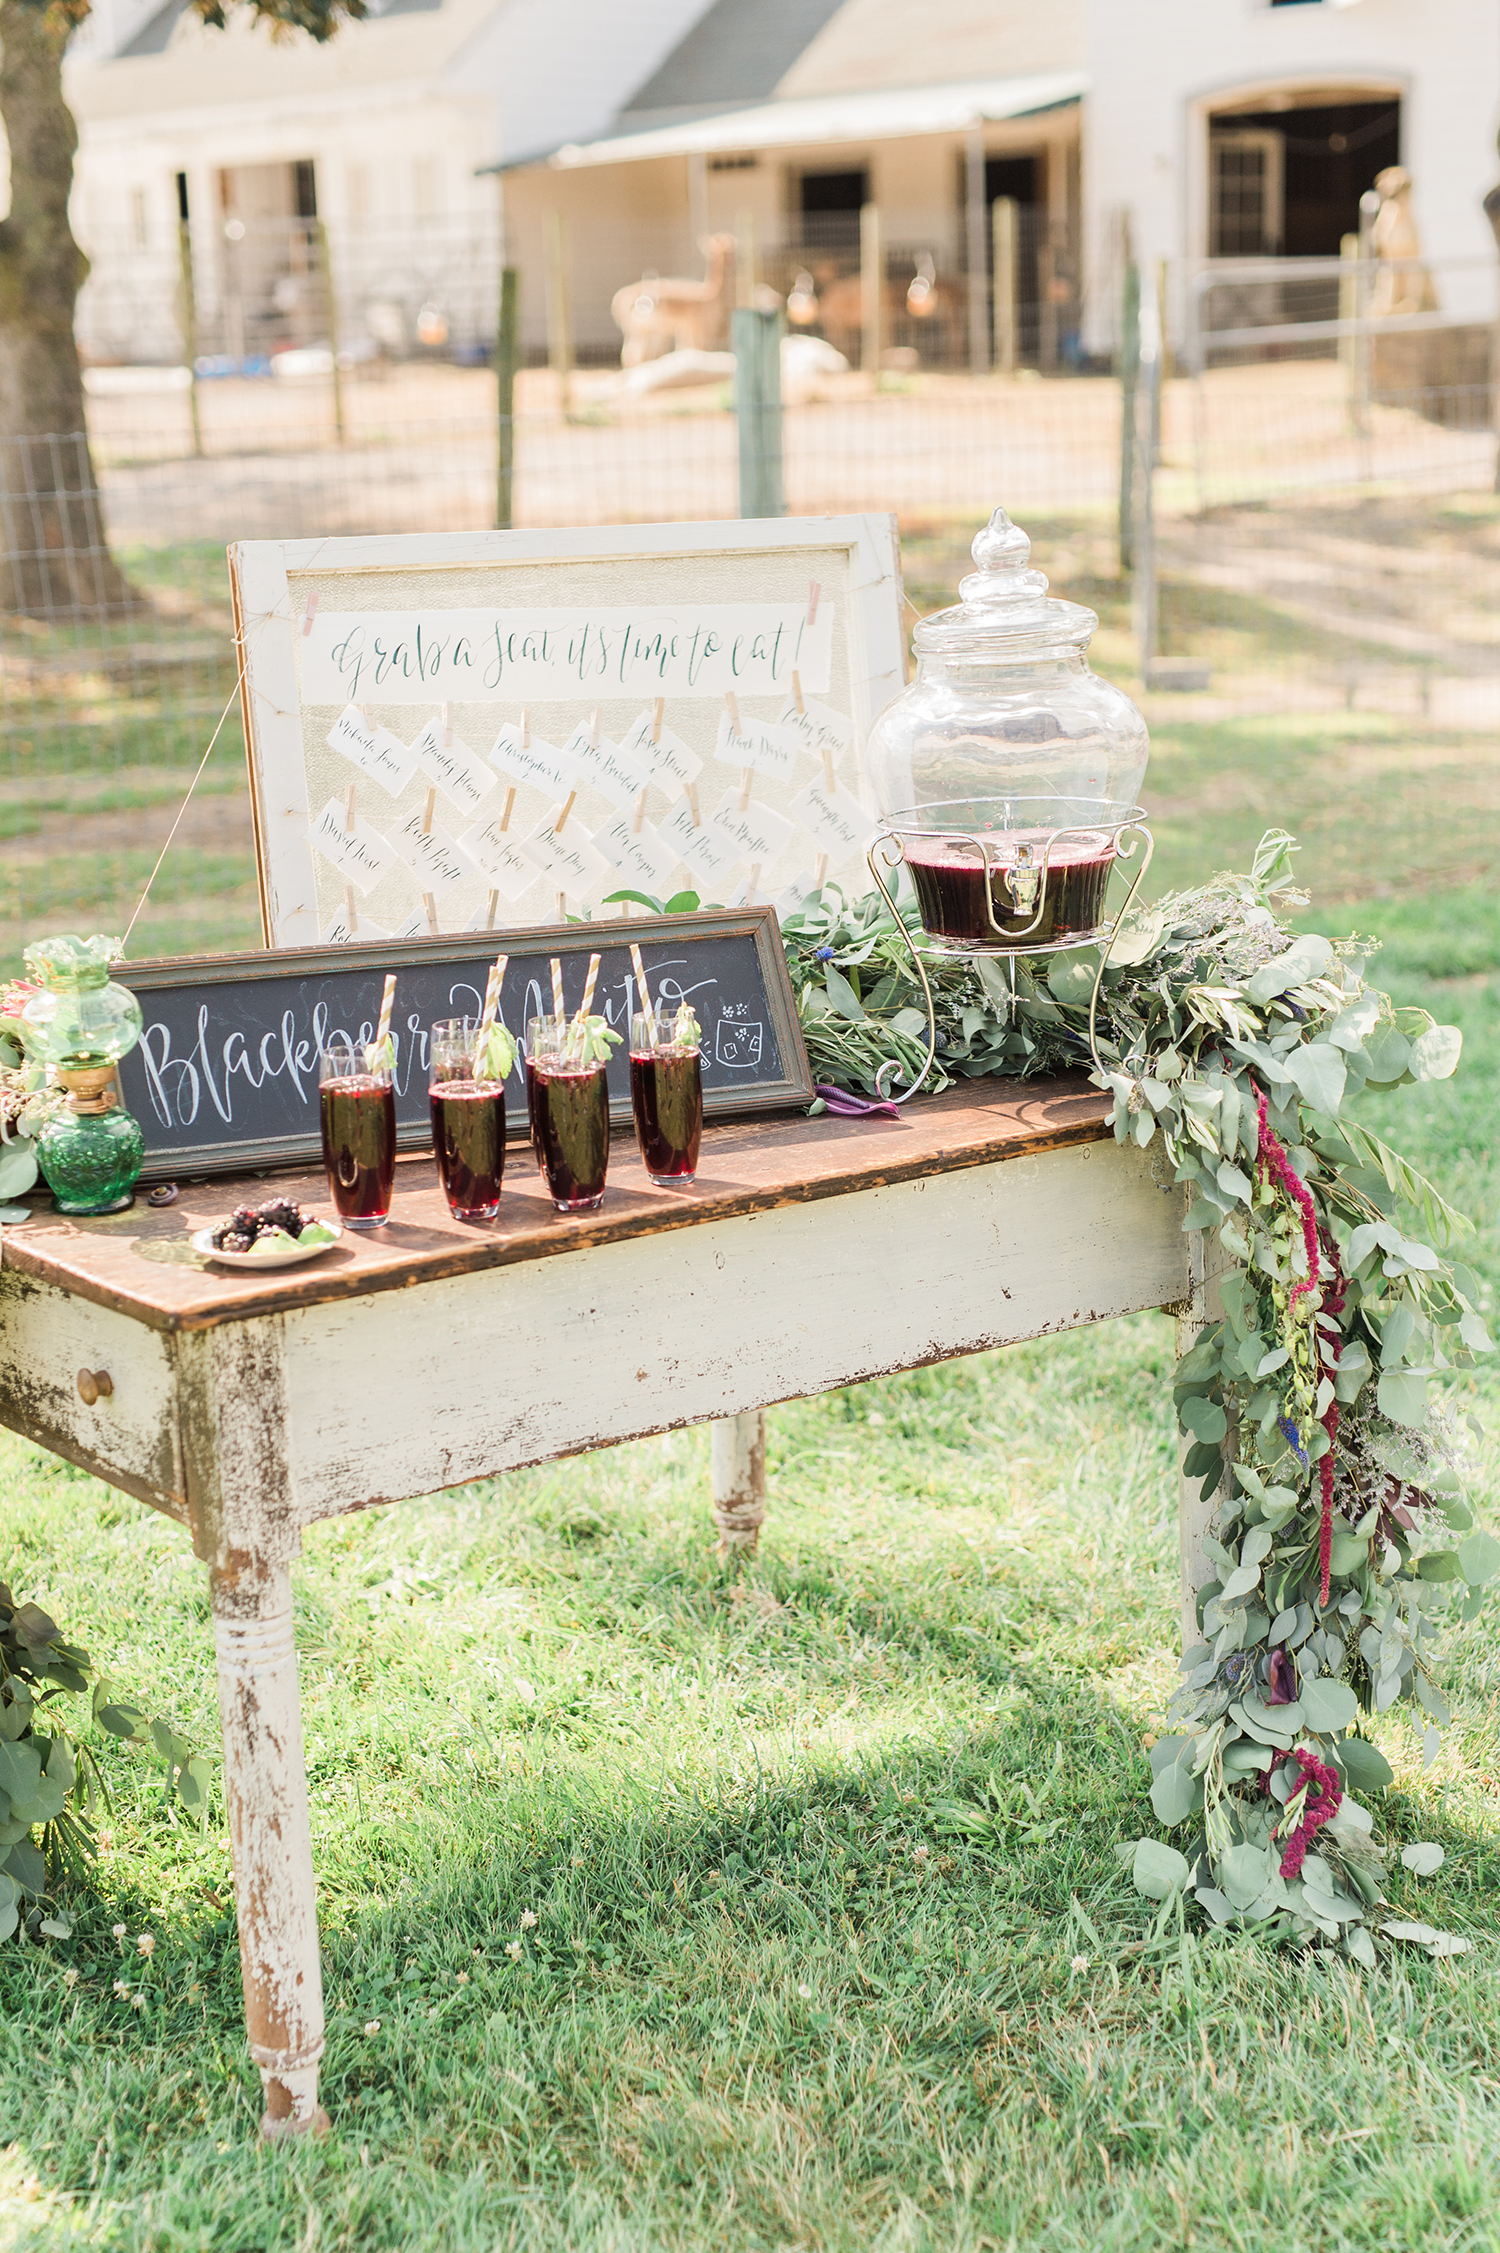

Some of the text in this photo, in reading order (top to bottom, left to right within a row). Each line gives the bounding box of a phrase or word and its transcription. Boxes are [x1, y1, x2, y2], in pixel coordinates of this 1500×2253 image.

[331, 624, 451, 700] Grab
[453, 636, 478, 668] a
[686, 624, 742, 687] to
